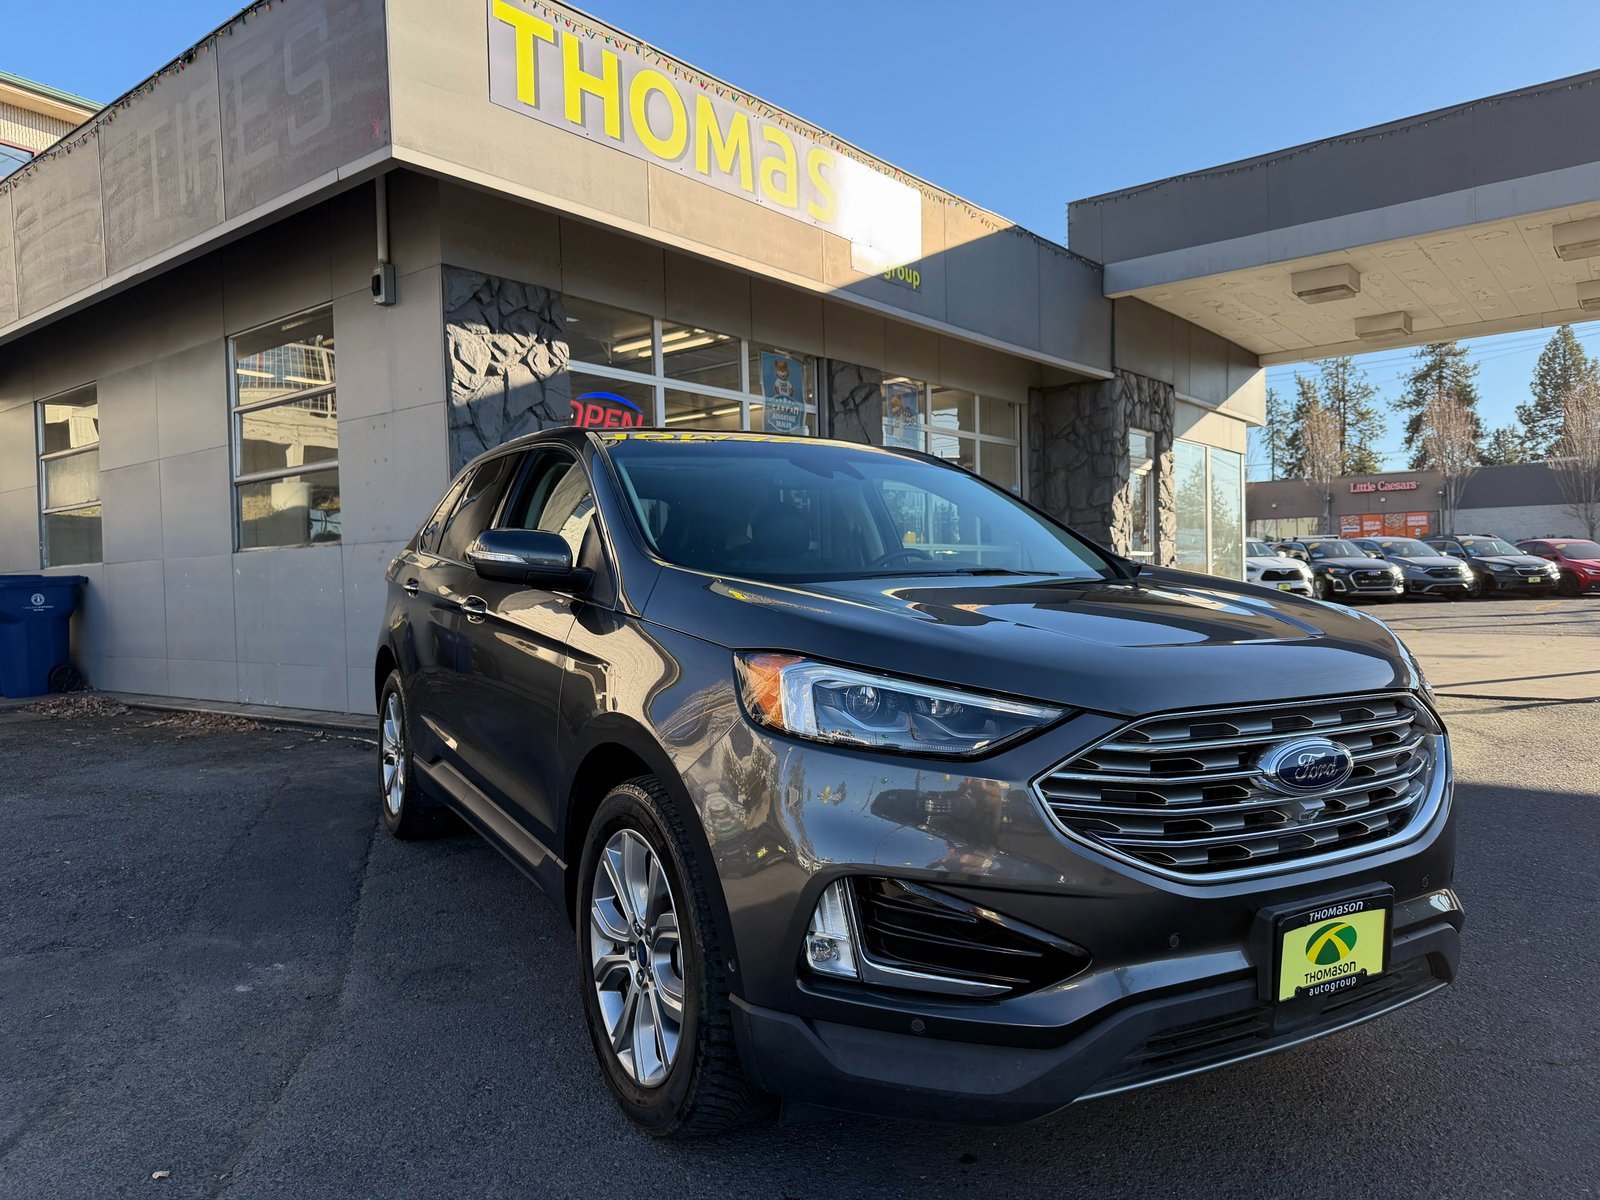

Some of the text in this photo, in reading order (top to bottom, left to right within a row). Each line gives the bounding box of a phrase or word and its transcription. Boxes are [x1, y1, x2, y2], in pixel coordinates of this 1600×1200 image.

[1350, 481, 1417, 493] Little Caesars
[1294, 752, 1339, 780] Ford
[1309, 976, 1357, 996] autogroup
